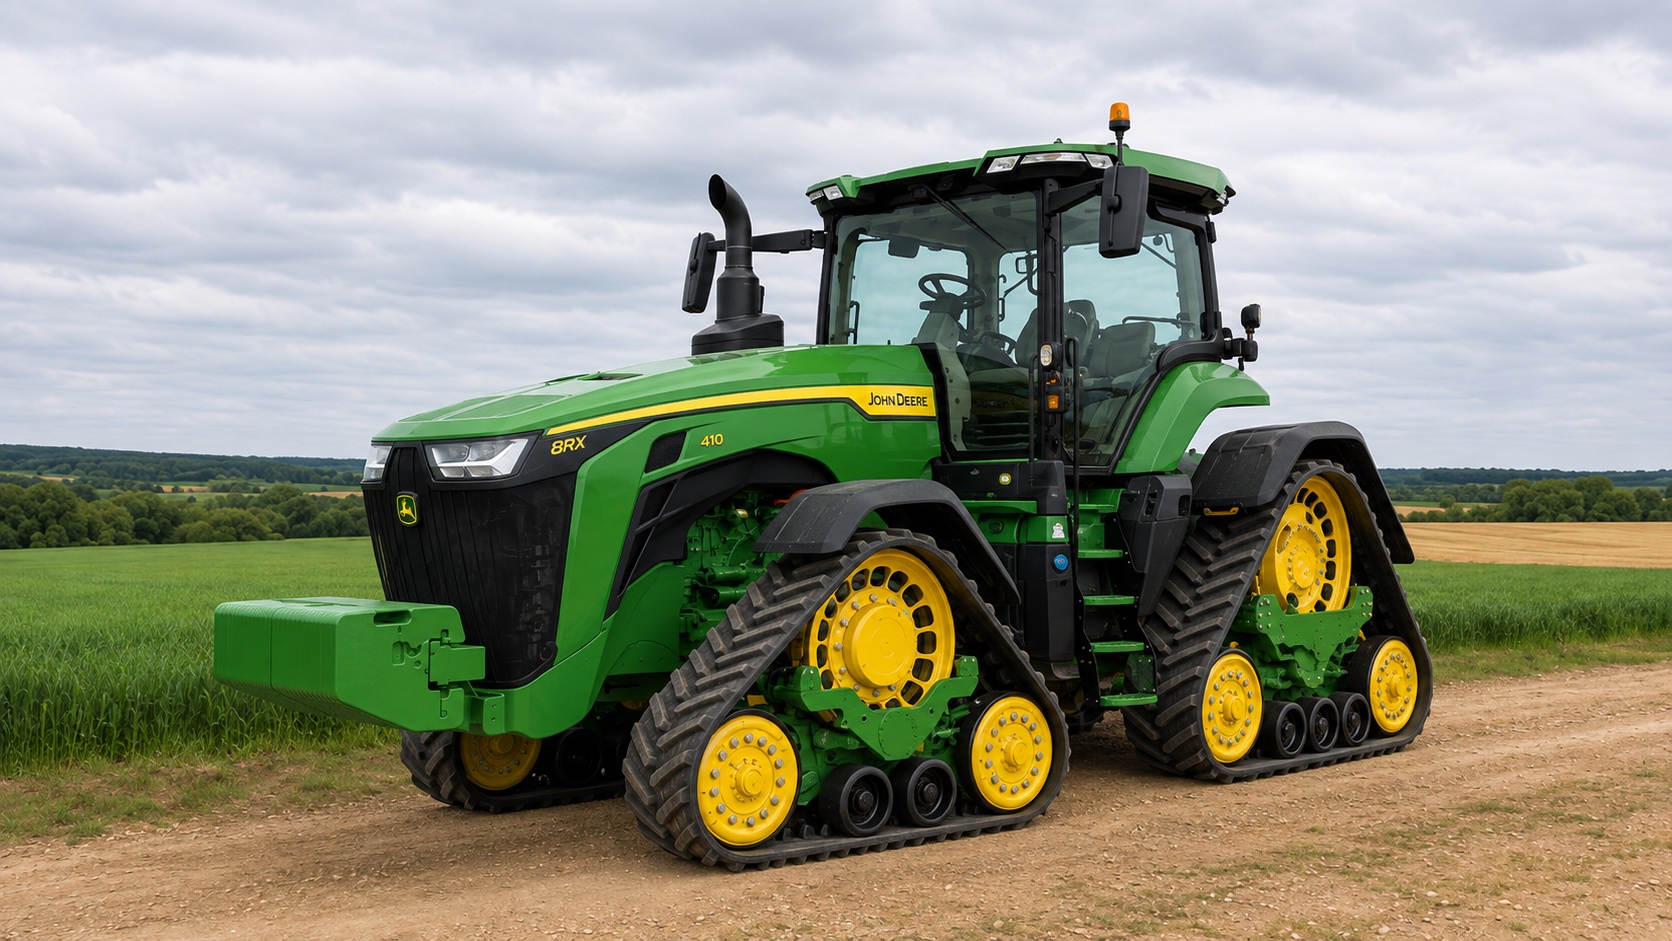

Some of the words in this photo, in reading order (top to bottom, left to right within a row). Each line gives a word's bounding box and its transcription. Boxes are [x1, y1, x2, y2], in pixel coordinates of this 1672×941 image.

[868, 392, 895, 406] JOHN
[896, 393, 928, 407] DEERE
[550, 435, 587, 455] 8RX
[700, 433, 723, 447] 410
